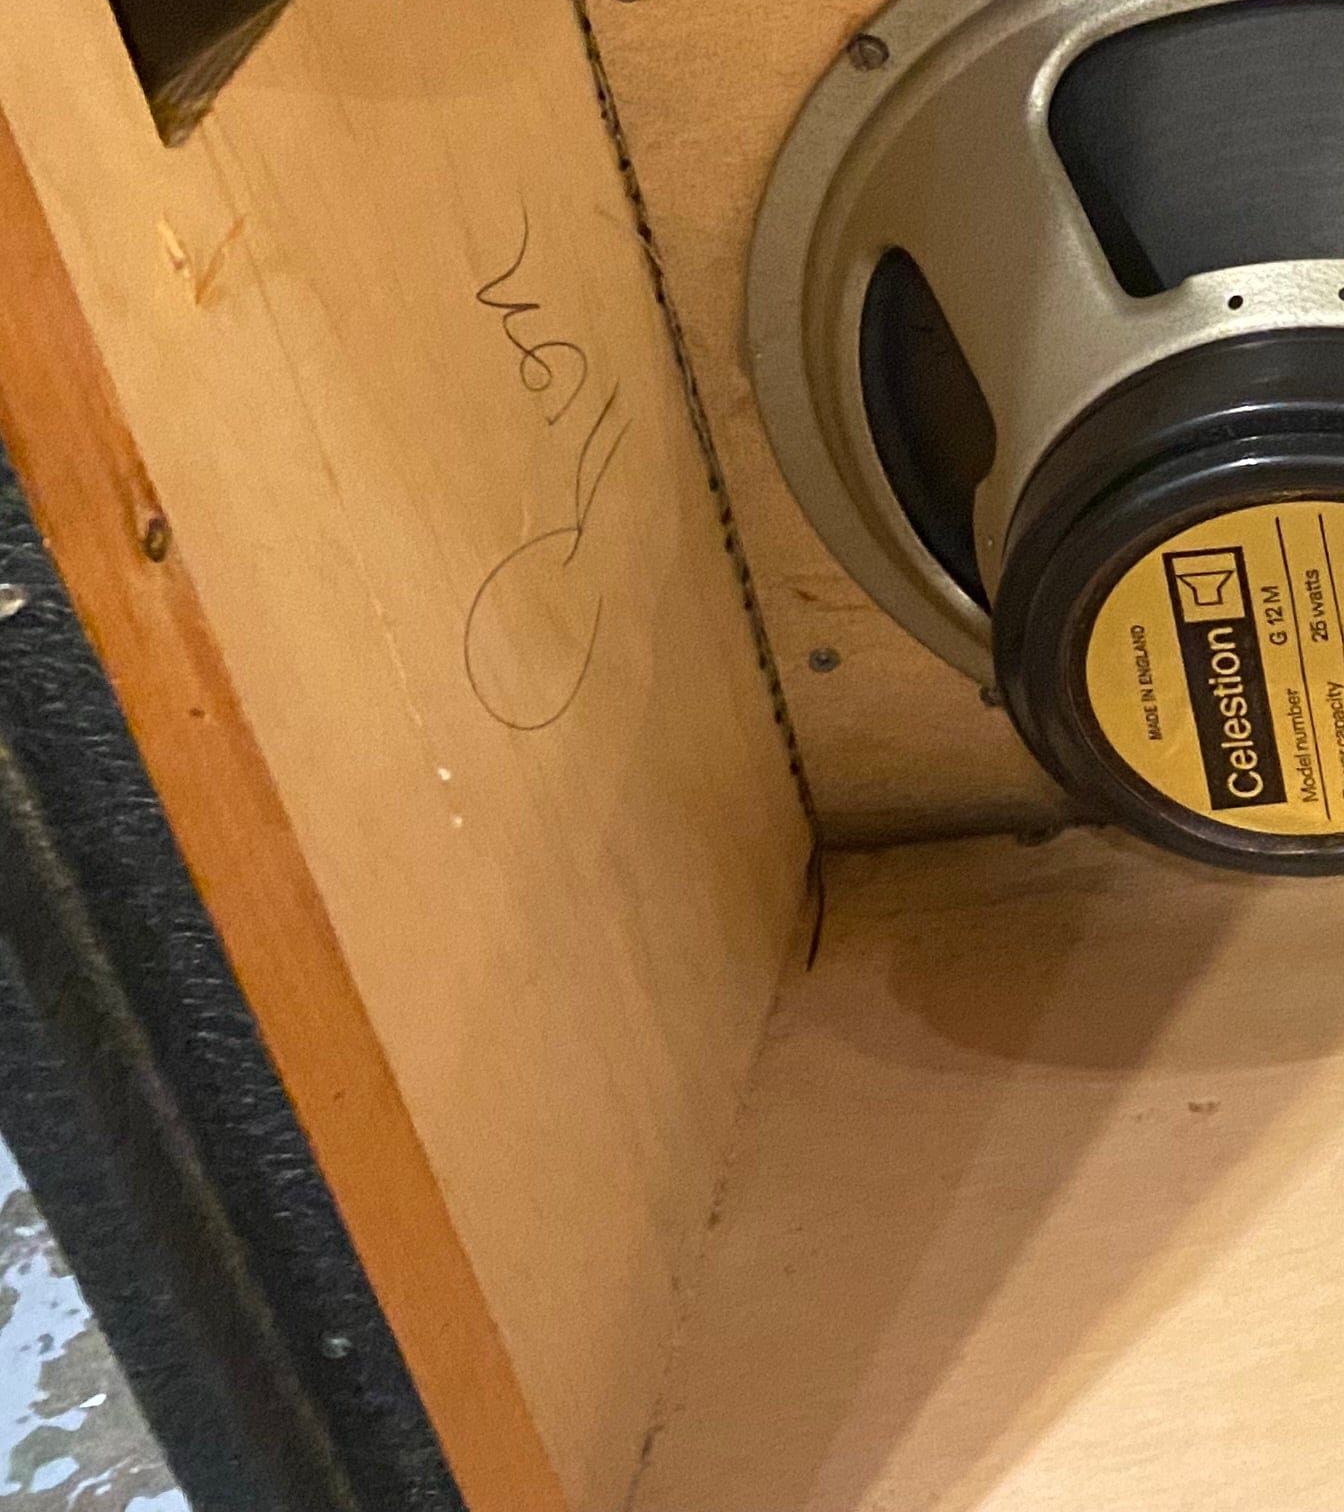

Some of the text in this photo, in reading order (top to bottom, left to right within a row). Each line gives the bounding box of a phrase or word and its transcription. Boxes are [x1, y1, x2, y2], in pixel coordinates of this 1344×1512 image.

[1304, 568, 1325, 618] watts
[1270, 630, 1288, 645] G
[1130, 625, 1162, 740] MADE IN ENGLAND
[1207, 626, 1264, 798] Celestion
[1287, 688, 1308, 750] number
[1296, 751, 1319, 803] Model
